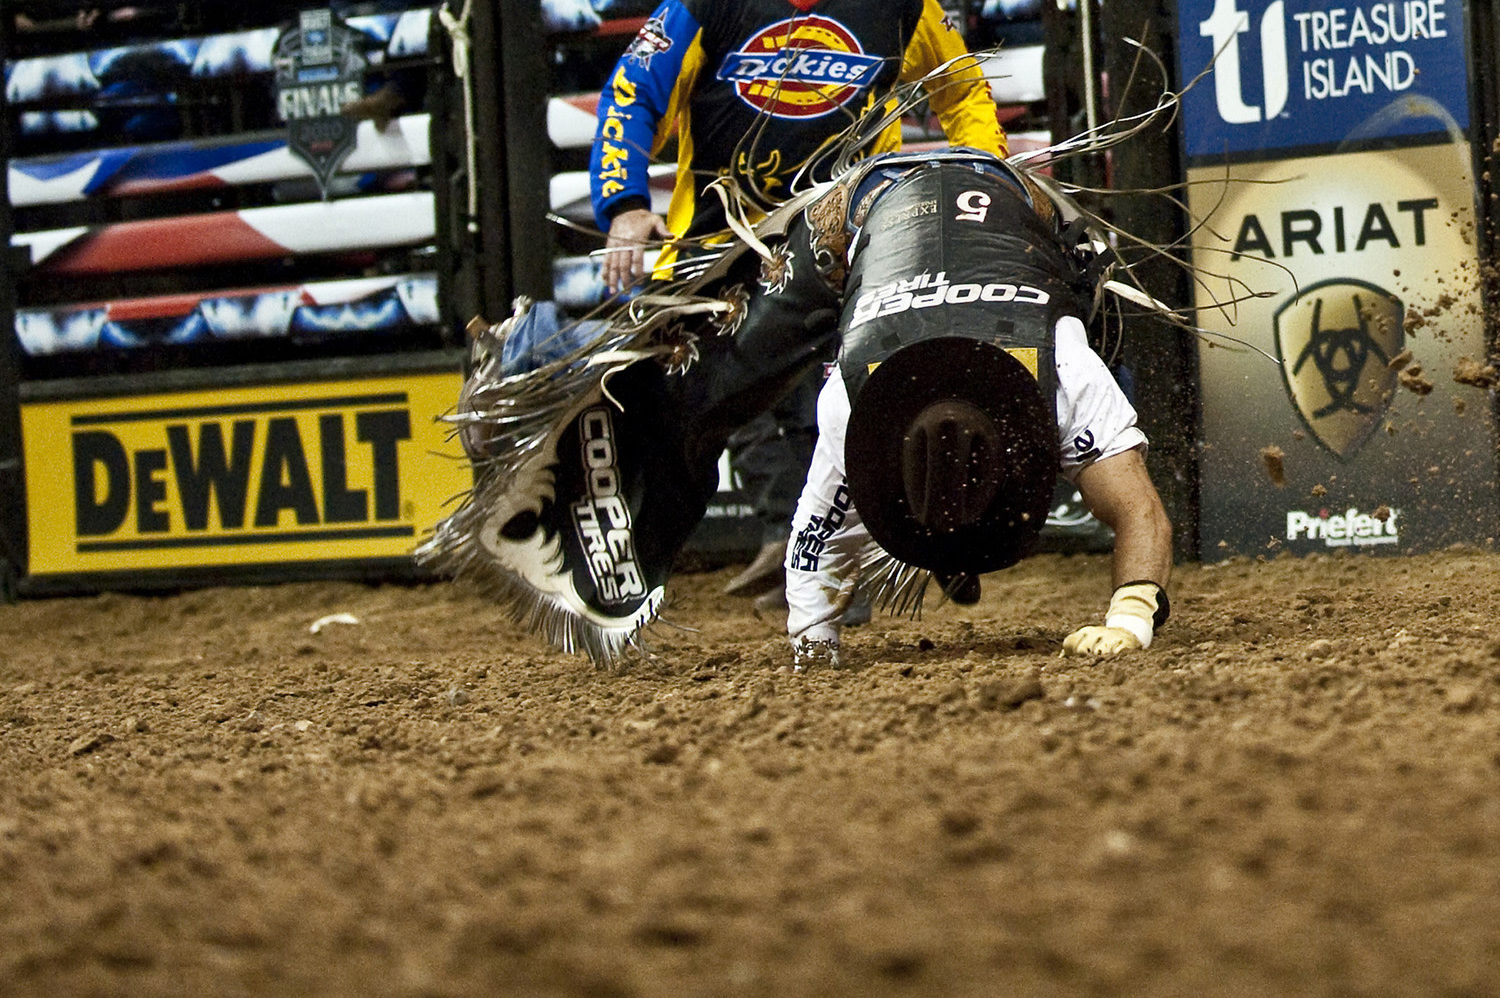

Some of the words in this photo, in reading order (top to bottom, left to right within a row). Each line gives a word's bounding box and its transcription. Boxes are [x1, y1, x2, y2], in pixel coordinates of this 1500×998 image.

[1304, 51, 1415, 100] ISLAND
[955, 190, 992, 224] 5
[1230, 198, 1439, 261] ARIAT
[850, 283, 1050, 329] COOPER
[583, 410, 645, 599] COOPER
[577, 505, 620, 601] TIRES
